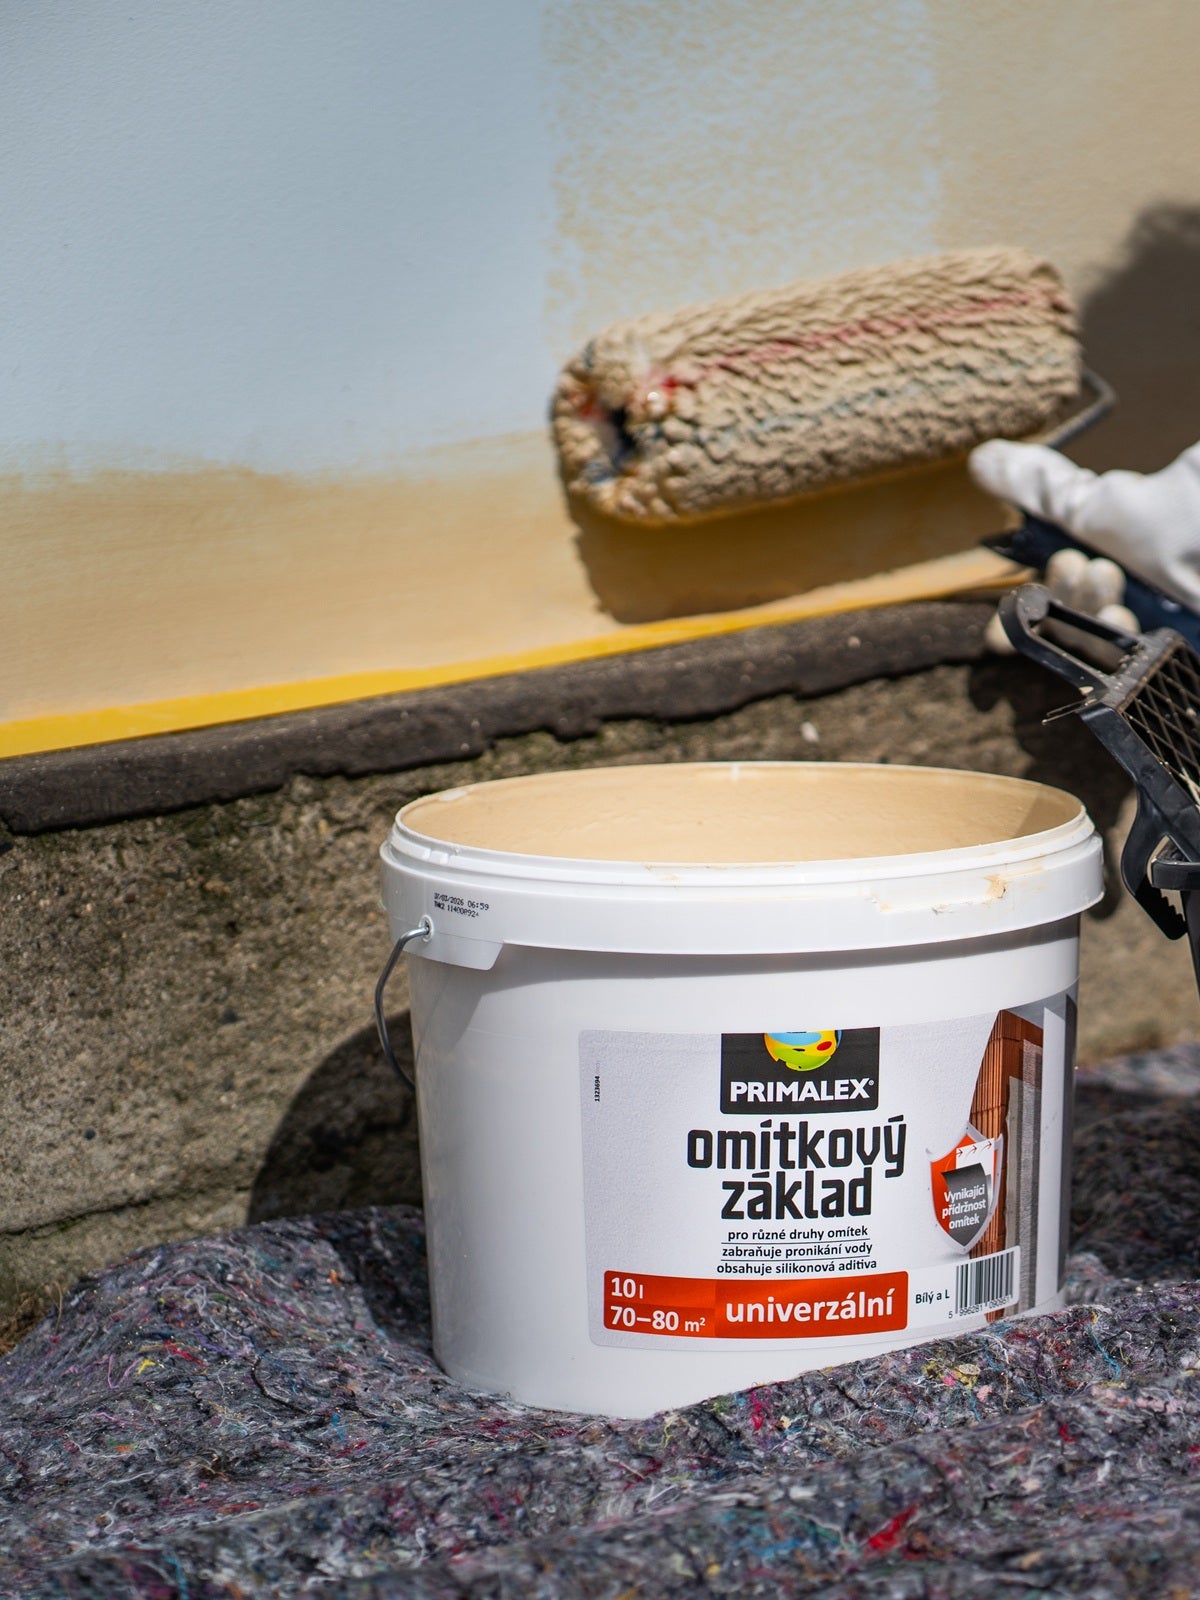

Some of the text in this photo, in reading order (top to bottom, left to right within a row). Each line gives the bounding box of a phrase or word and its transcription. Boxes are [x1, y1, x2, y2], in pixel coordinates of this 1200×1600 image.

[467, 900, 490, 911] 06:59
[687, 1114, 906, 1178] omítkový
[721, 1166, 872, 1219] základ
[944, 1184, 985, 1203] Vynikající
[942, 1199, 987, 1219] přídržnost
[949, 1214, 980, 1230] omítek
[728, 1225, 868, 1242] pro různé druhy omítek
[722, 1242, 873, 1259] zabraňuje pronikání vody
[717, 1259, 877, 1275] obsahuje silikonová aditiva
[611, 1277, 636, 1299] 10
[916, 1289, 950, 1304] Bílý a L
[726, 1287, 896, 1323] univerzální
